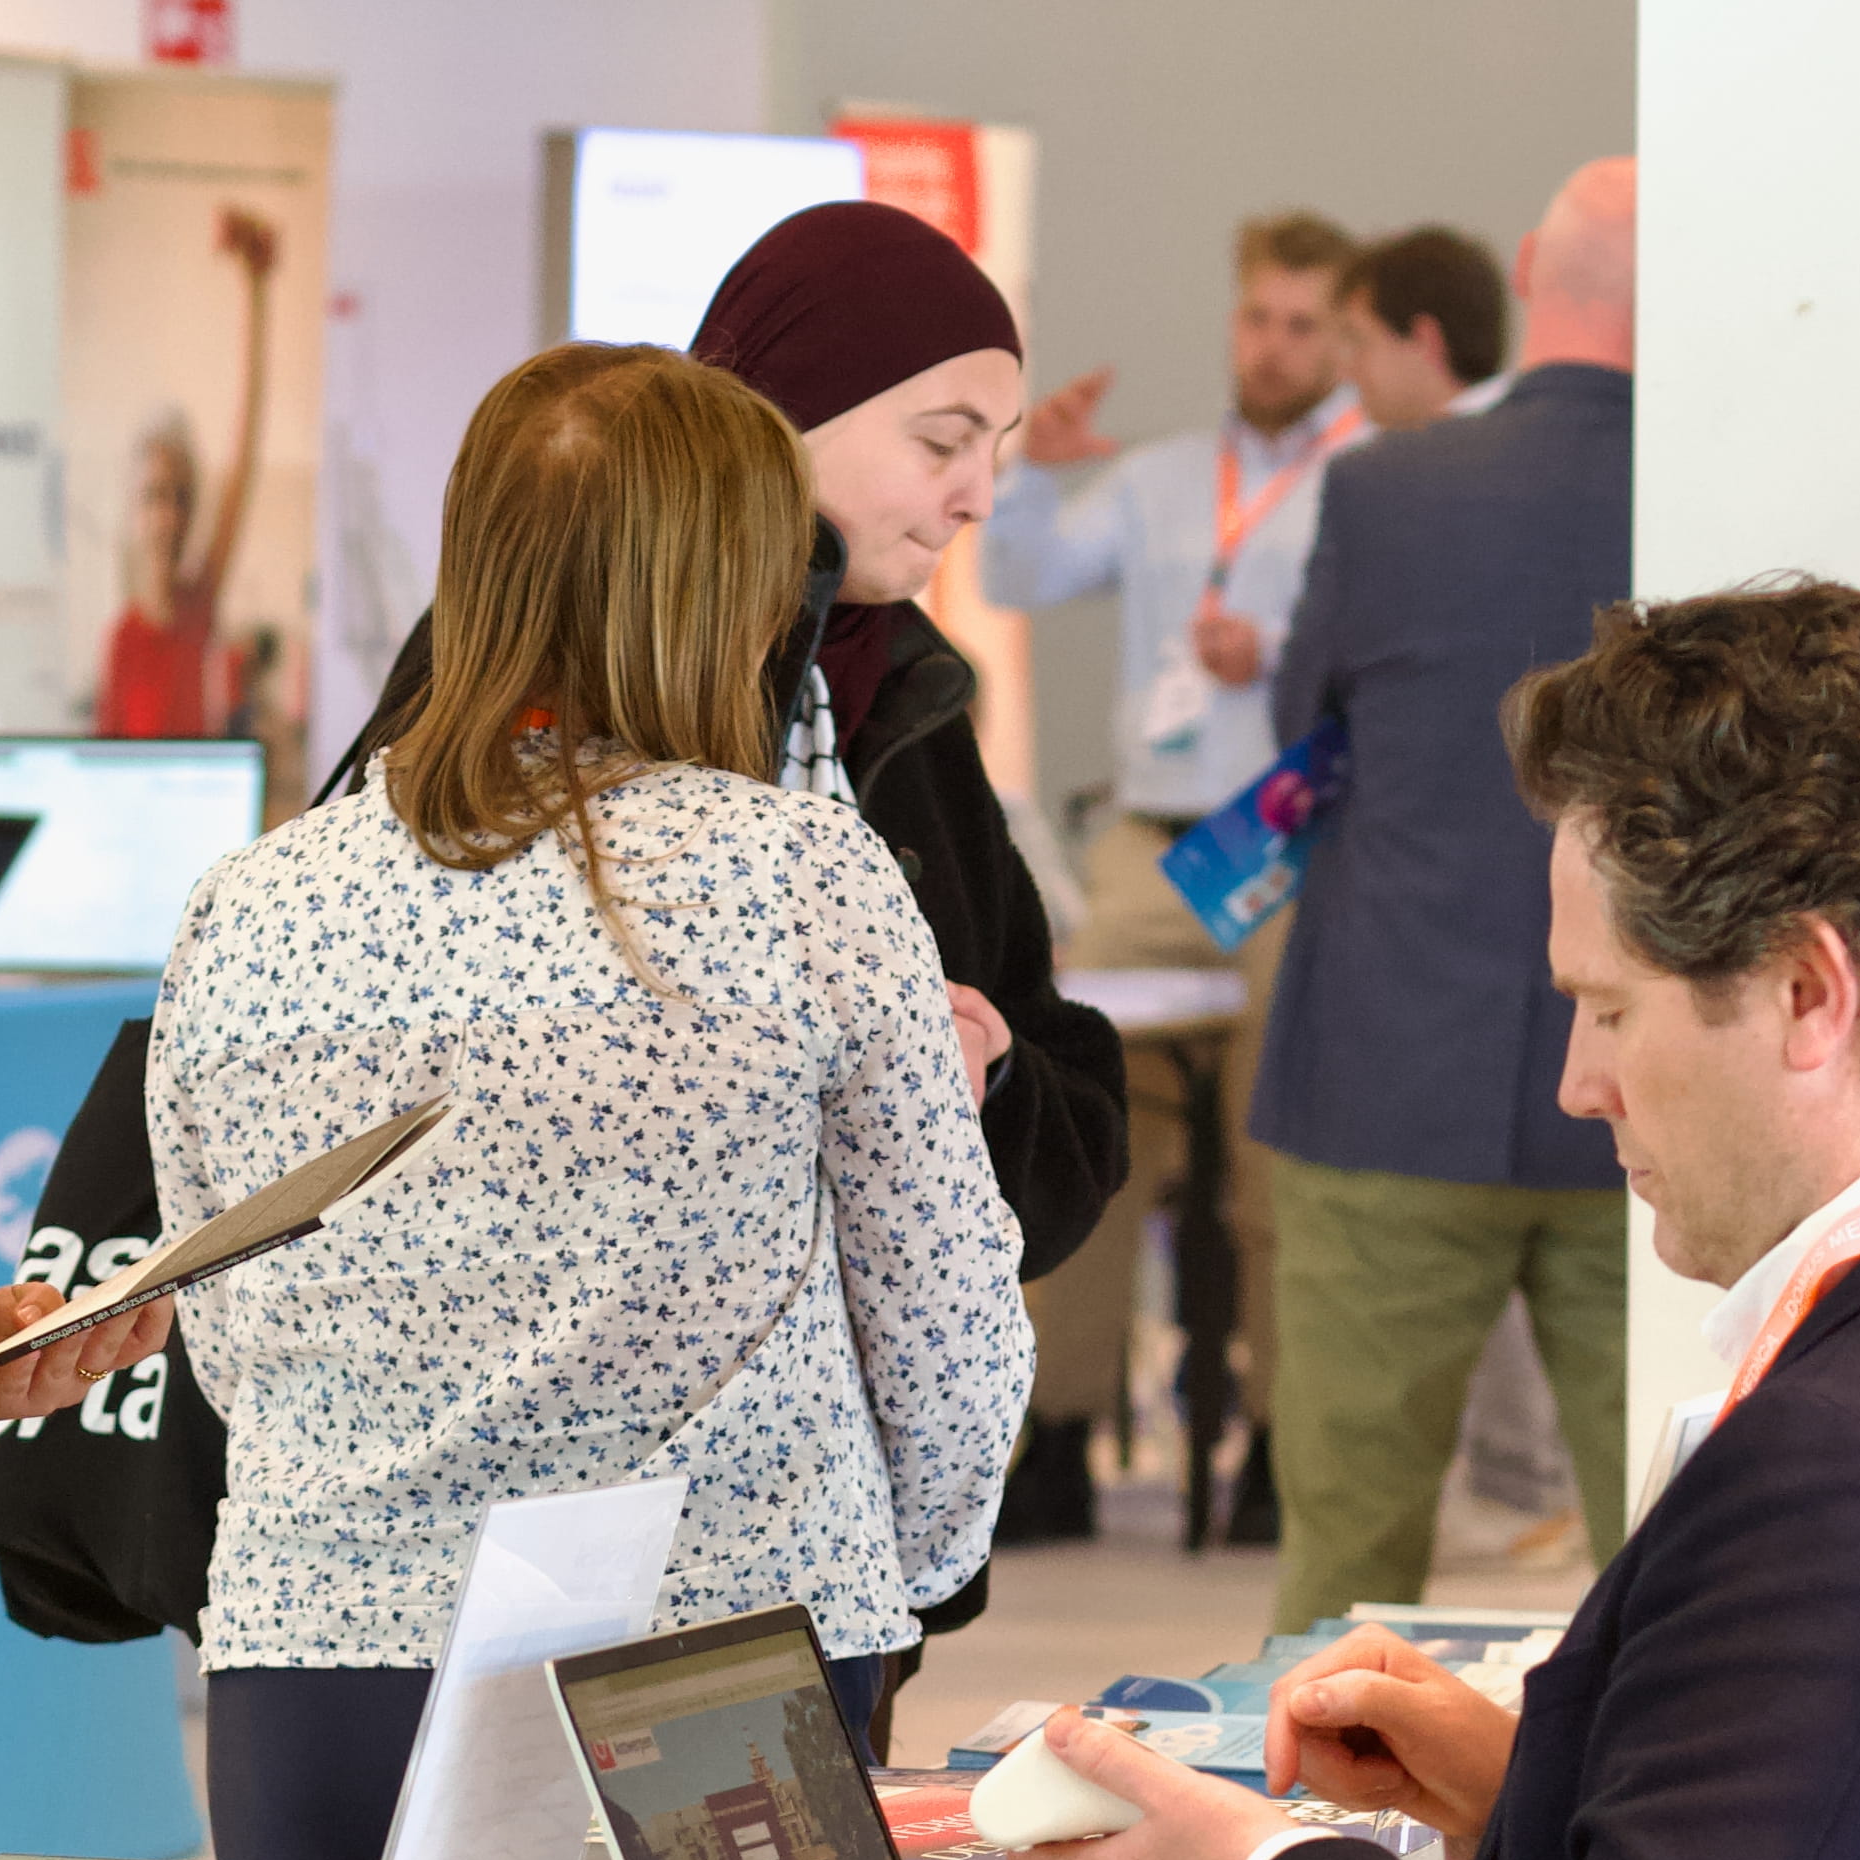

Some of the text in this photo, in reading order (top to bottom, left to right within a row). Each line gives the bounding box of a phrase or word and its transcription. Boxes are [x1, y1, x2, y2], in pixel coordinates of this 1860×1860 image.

[29, 1280, 179, 1350] Aan weerszijden van de stethoscoop
